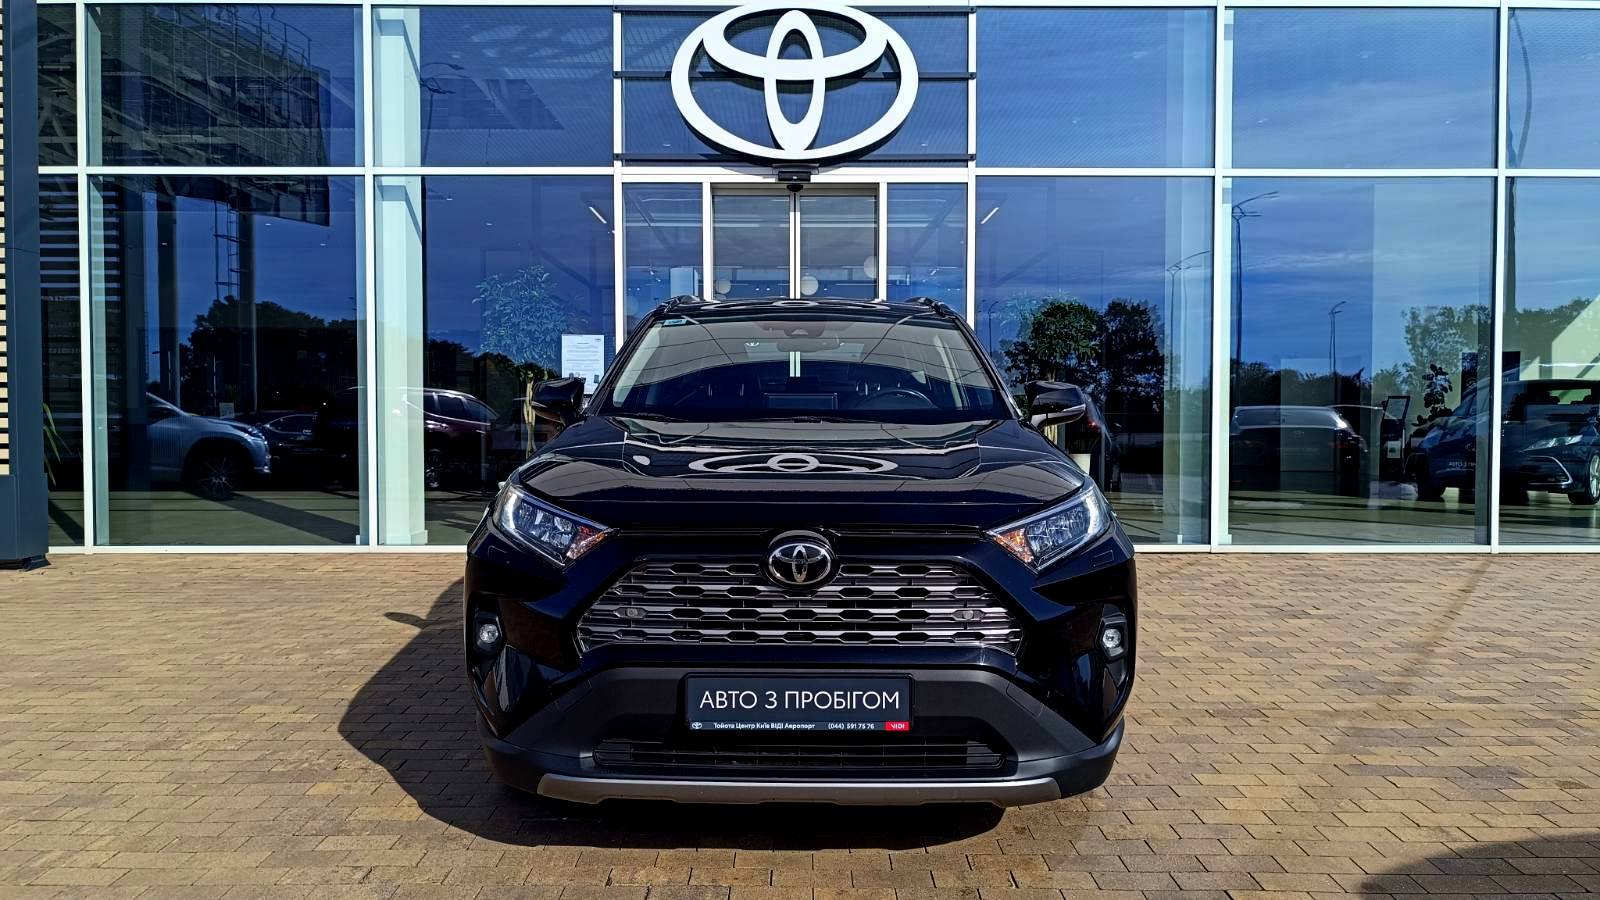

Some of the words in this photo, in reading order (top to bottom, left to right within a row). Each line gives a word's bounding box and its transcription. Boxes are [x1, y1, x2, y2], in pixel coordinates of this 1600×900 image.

[699, 690, 758, 709] АВТО
[764, 690, 778, 709] З
[784, 690, 900, 709] ПРОБІГОМ
[736, 722, 756, 730] Центр
[770, 722, 784, 730] ВІДІ
[784, 722, 816, 730] Аеропорт
[828, 722, 845, 730] (044)
[846, 722, 857, 730] 591
[857, 722, 866, 730] 75
[866, 722, 875, 730] 76
